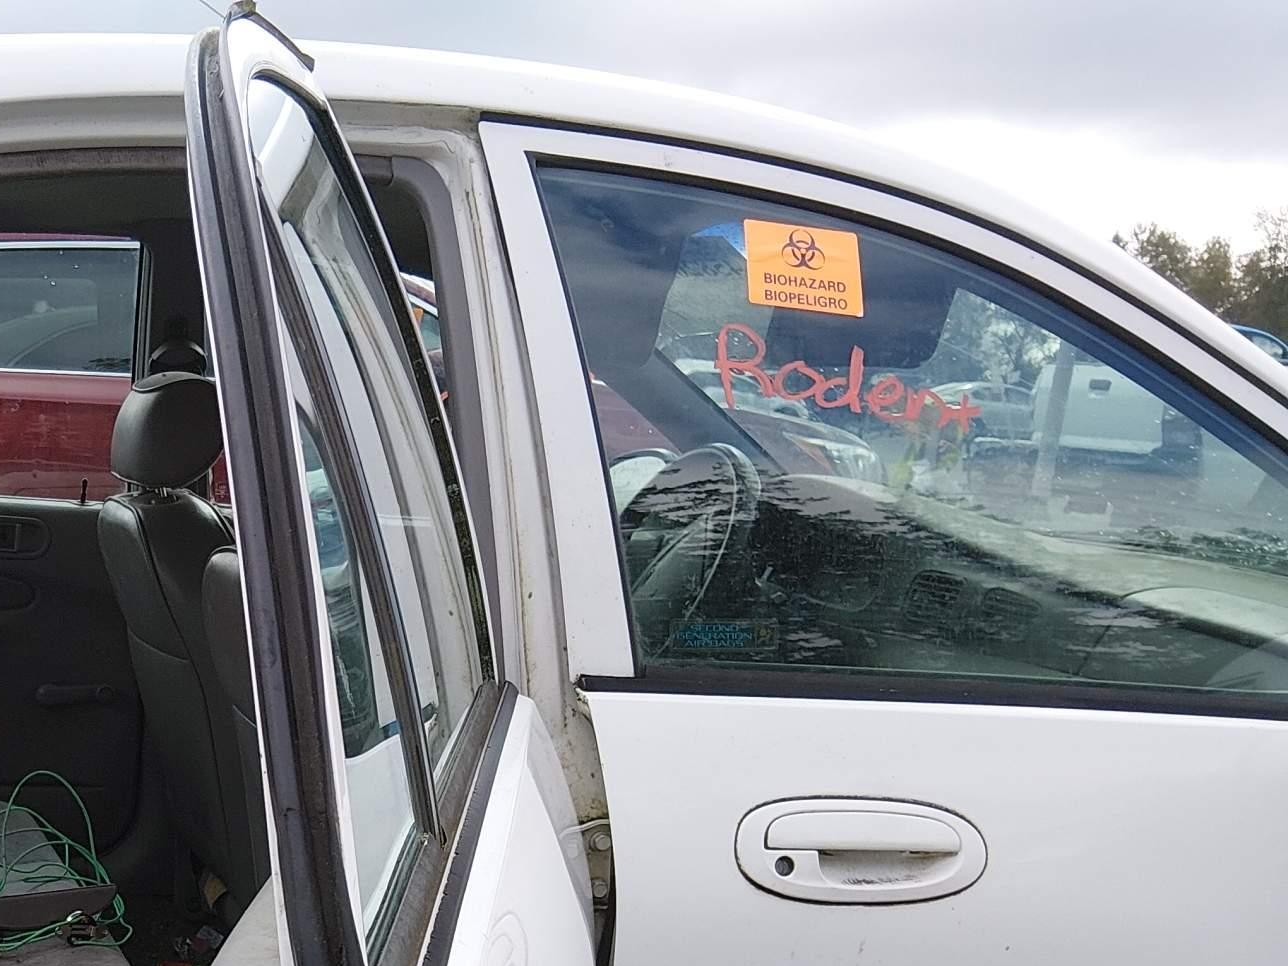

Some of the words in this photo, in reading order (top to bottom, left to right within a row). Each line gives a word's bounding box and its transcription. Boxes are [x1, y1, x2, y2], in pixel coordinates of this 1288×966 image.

[763, 272, 847, 293] BIOHAZARD
[764, 290, 849, 310] BIOPELIGRO
[715, 323, 981, 432] Rodent
[673, 632, 753, 640] GENERATION
[690, 624, 739, 632] SECOND
